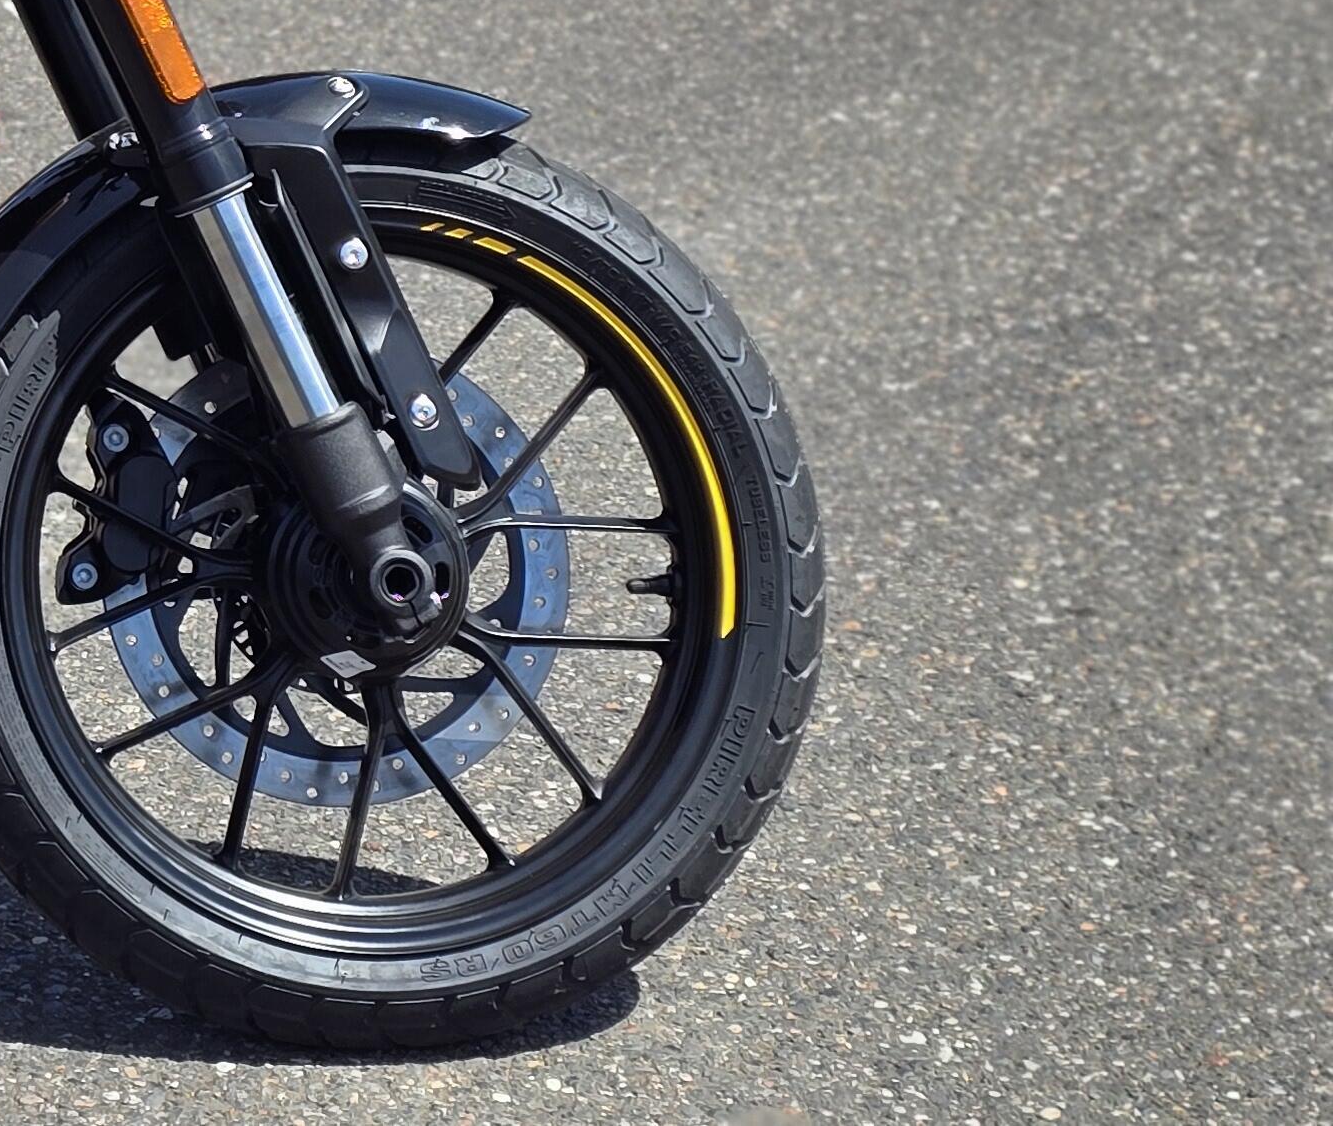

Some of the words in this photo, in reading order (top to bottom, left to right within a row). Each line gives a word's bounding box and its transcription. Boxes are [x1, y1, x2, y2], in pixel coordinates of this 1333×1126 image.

[632, 704, 757, 886] PIRELLI
[500, 880, 632, 964] MT60
[419, 954, 488, 982] RS
